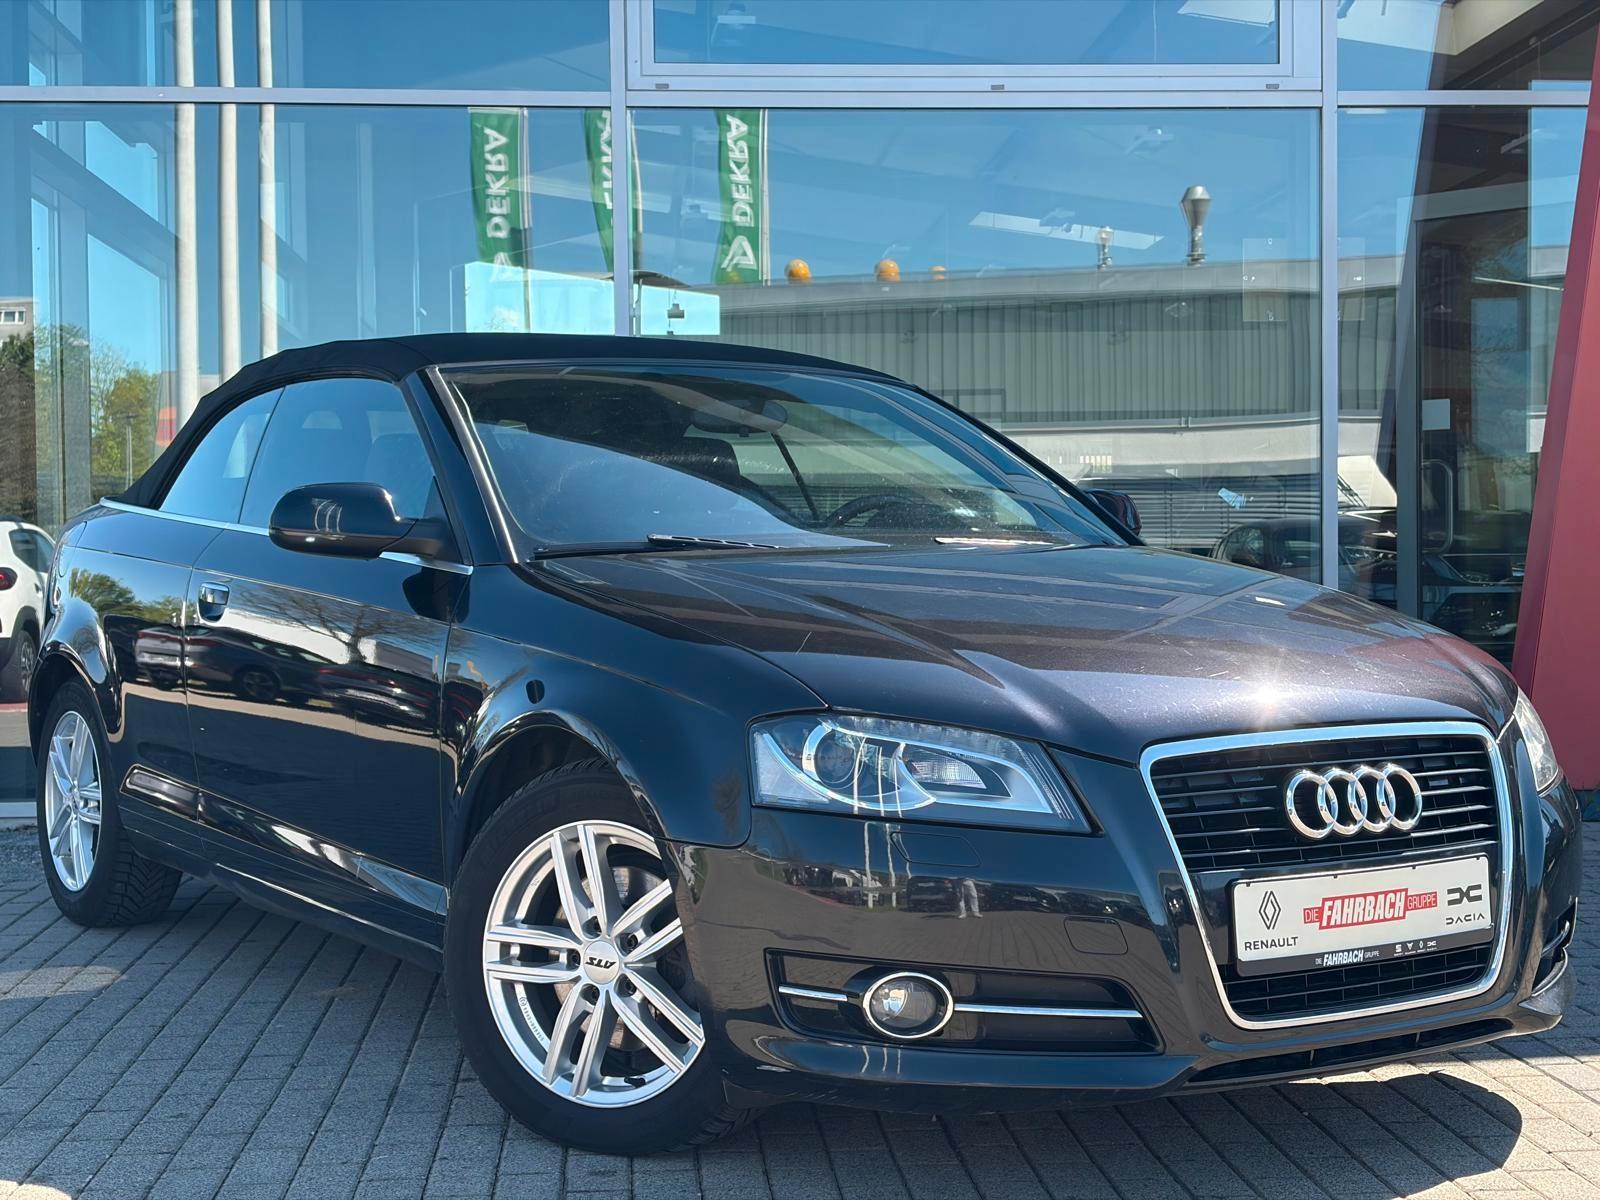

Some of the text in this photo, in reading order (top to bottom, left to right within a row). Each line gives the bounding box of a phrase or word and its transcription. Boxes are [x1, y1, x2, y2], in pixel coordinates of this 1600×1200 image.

[1304, 891, 1436, 927] DIE FAHRBACH GRUPPE
[1445, 912, 1485, 925] DACIA
[1244, 936, 1299, 951] RENAULT
[1323, 949, 1364, 967] FAHRBACH
